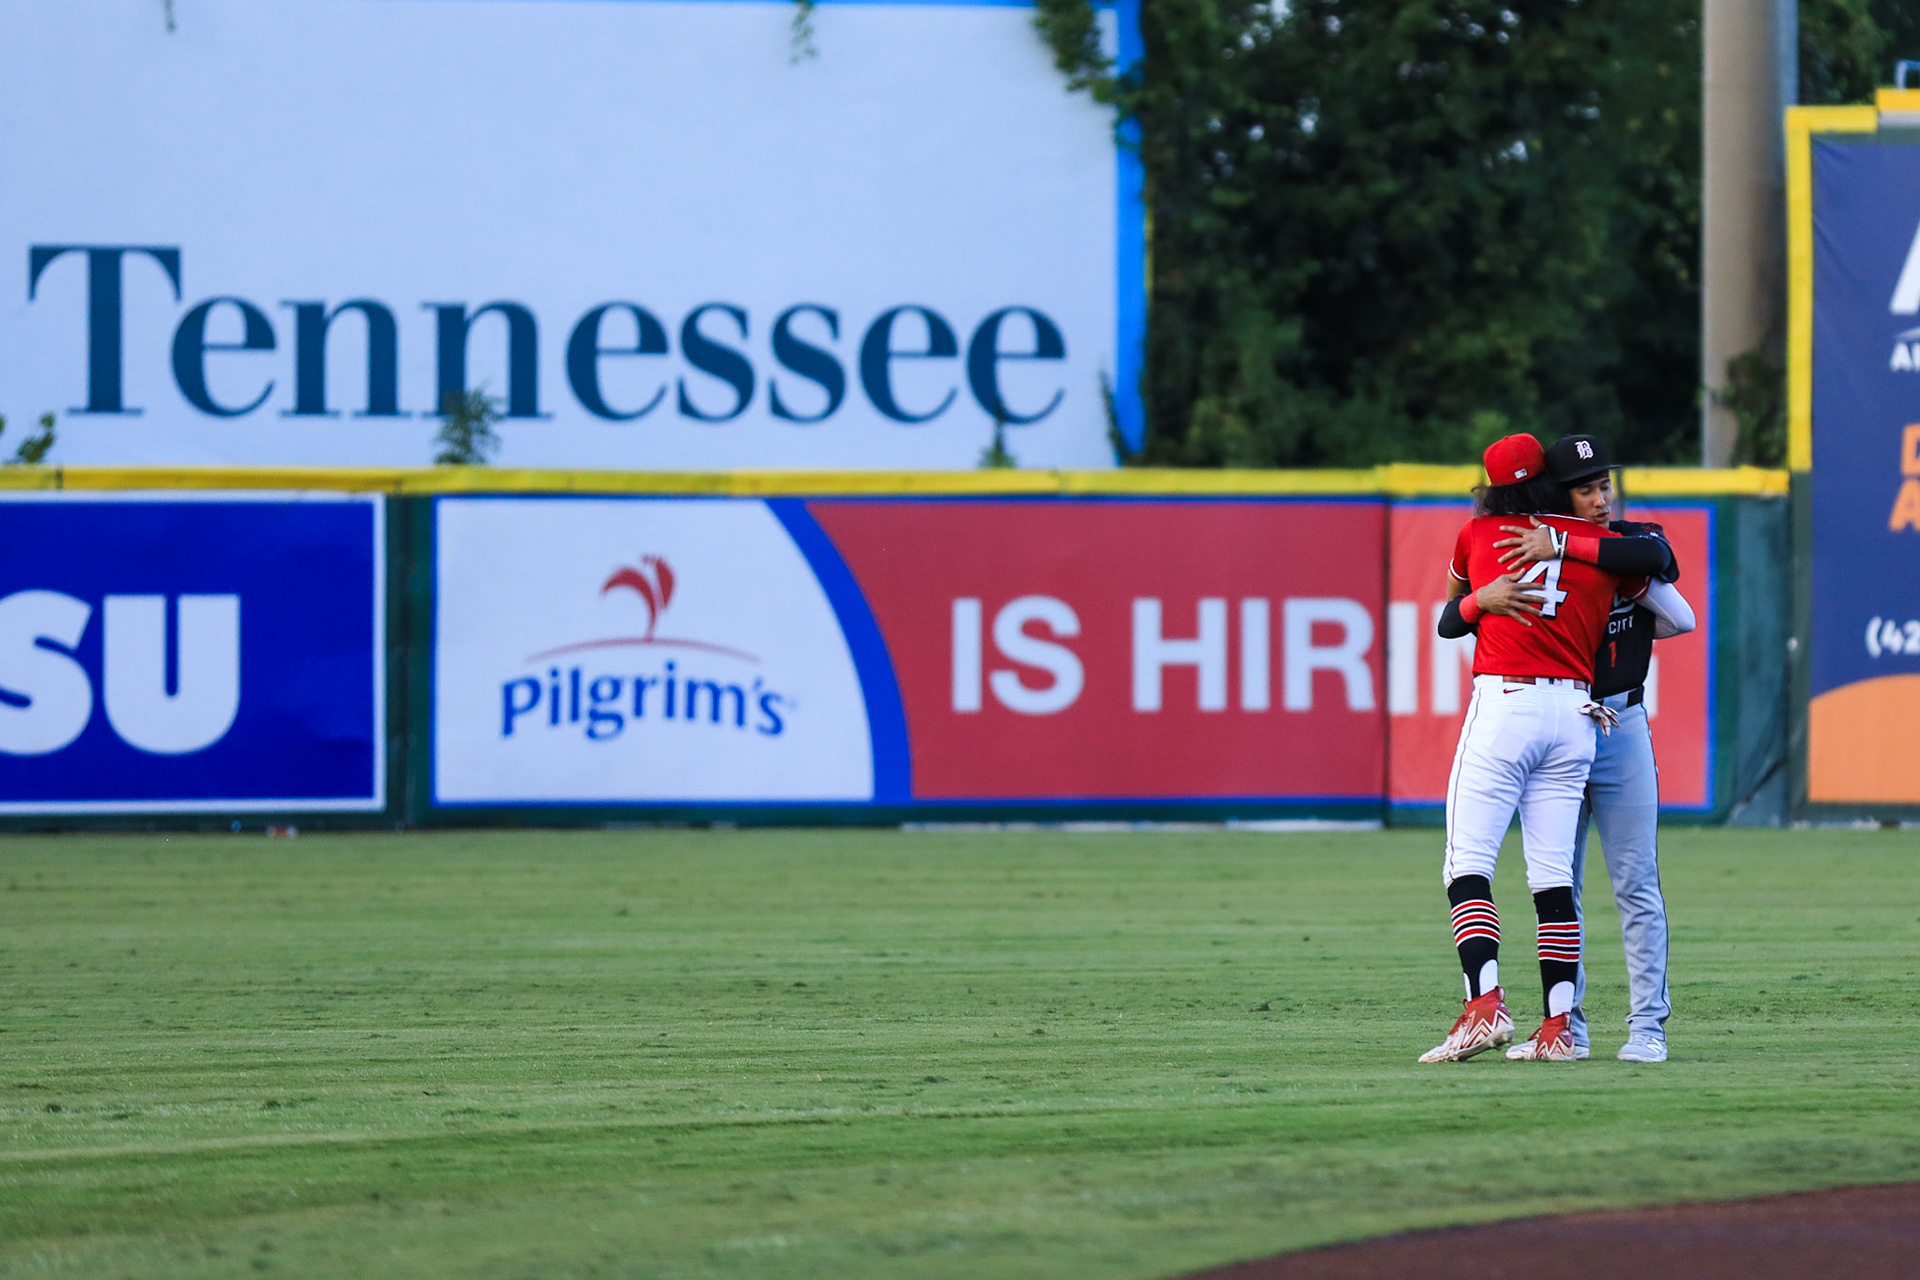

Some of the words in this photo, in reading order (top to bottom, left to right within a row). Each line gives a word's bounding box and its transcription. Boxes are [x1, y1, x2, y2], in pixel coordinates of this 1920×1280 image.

[28, 243, 1068, 426] Tennessee
[1516, 558, 1569, 619] 4
[1608, 615, 1634, 634] CITY
[1608, 641, 1617, 668] 1
[951, 595, 1085, 716] IS
[1132, 596, 1658, 716] HIRI
